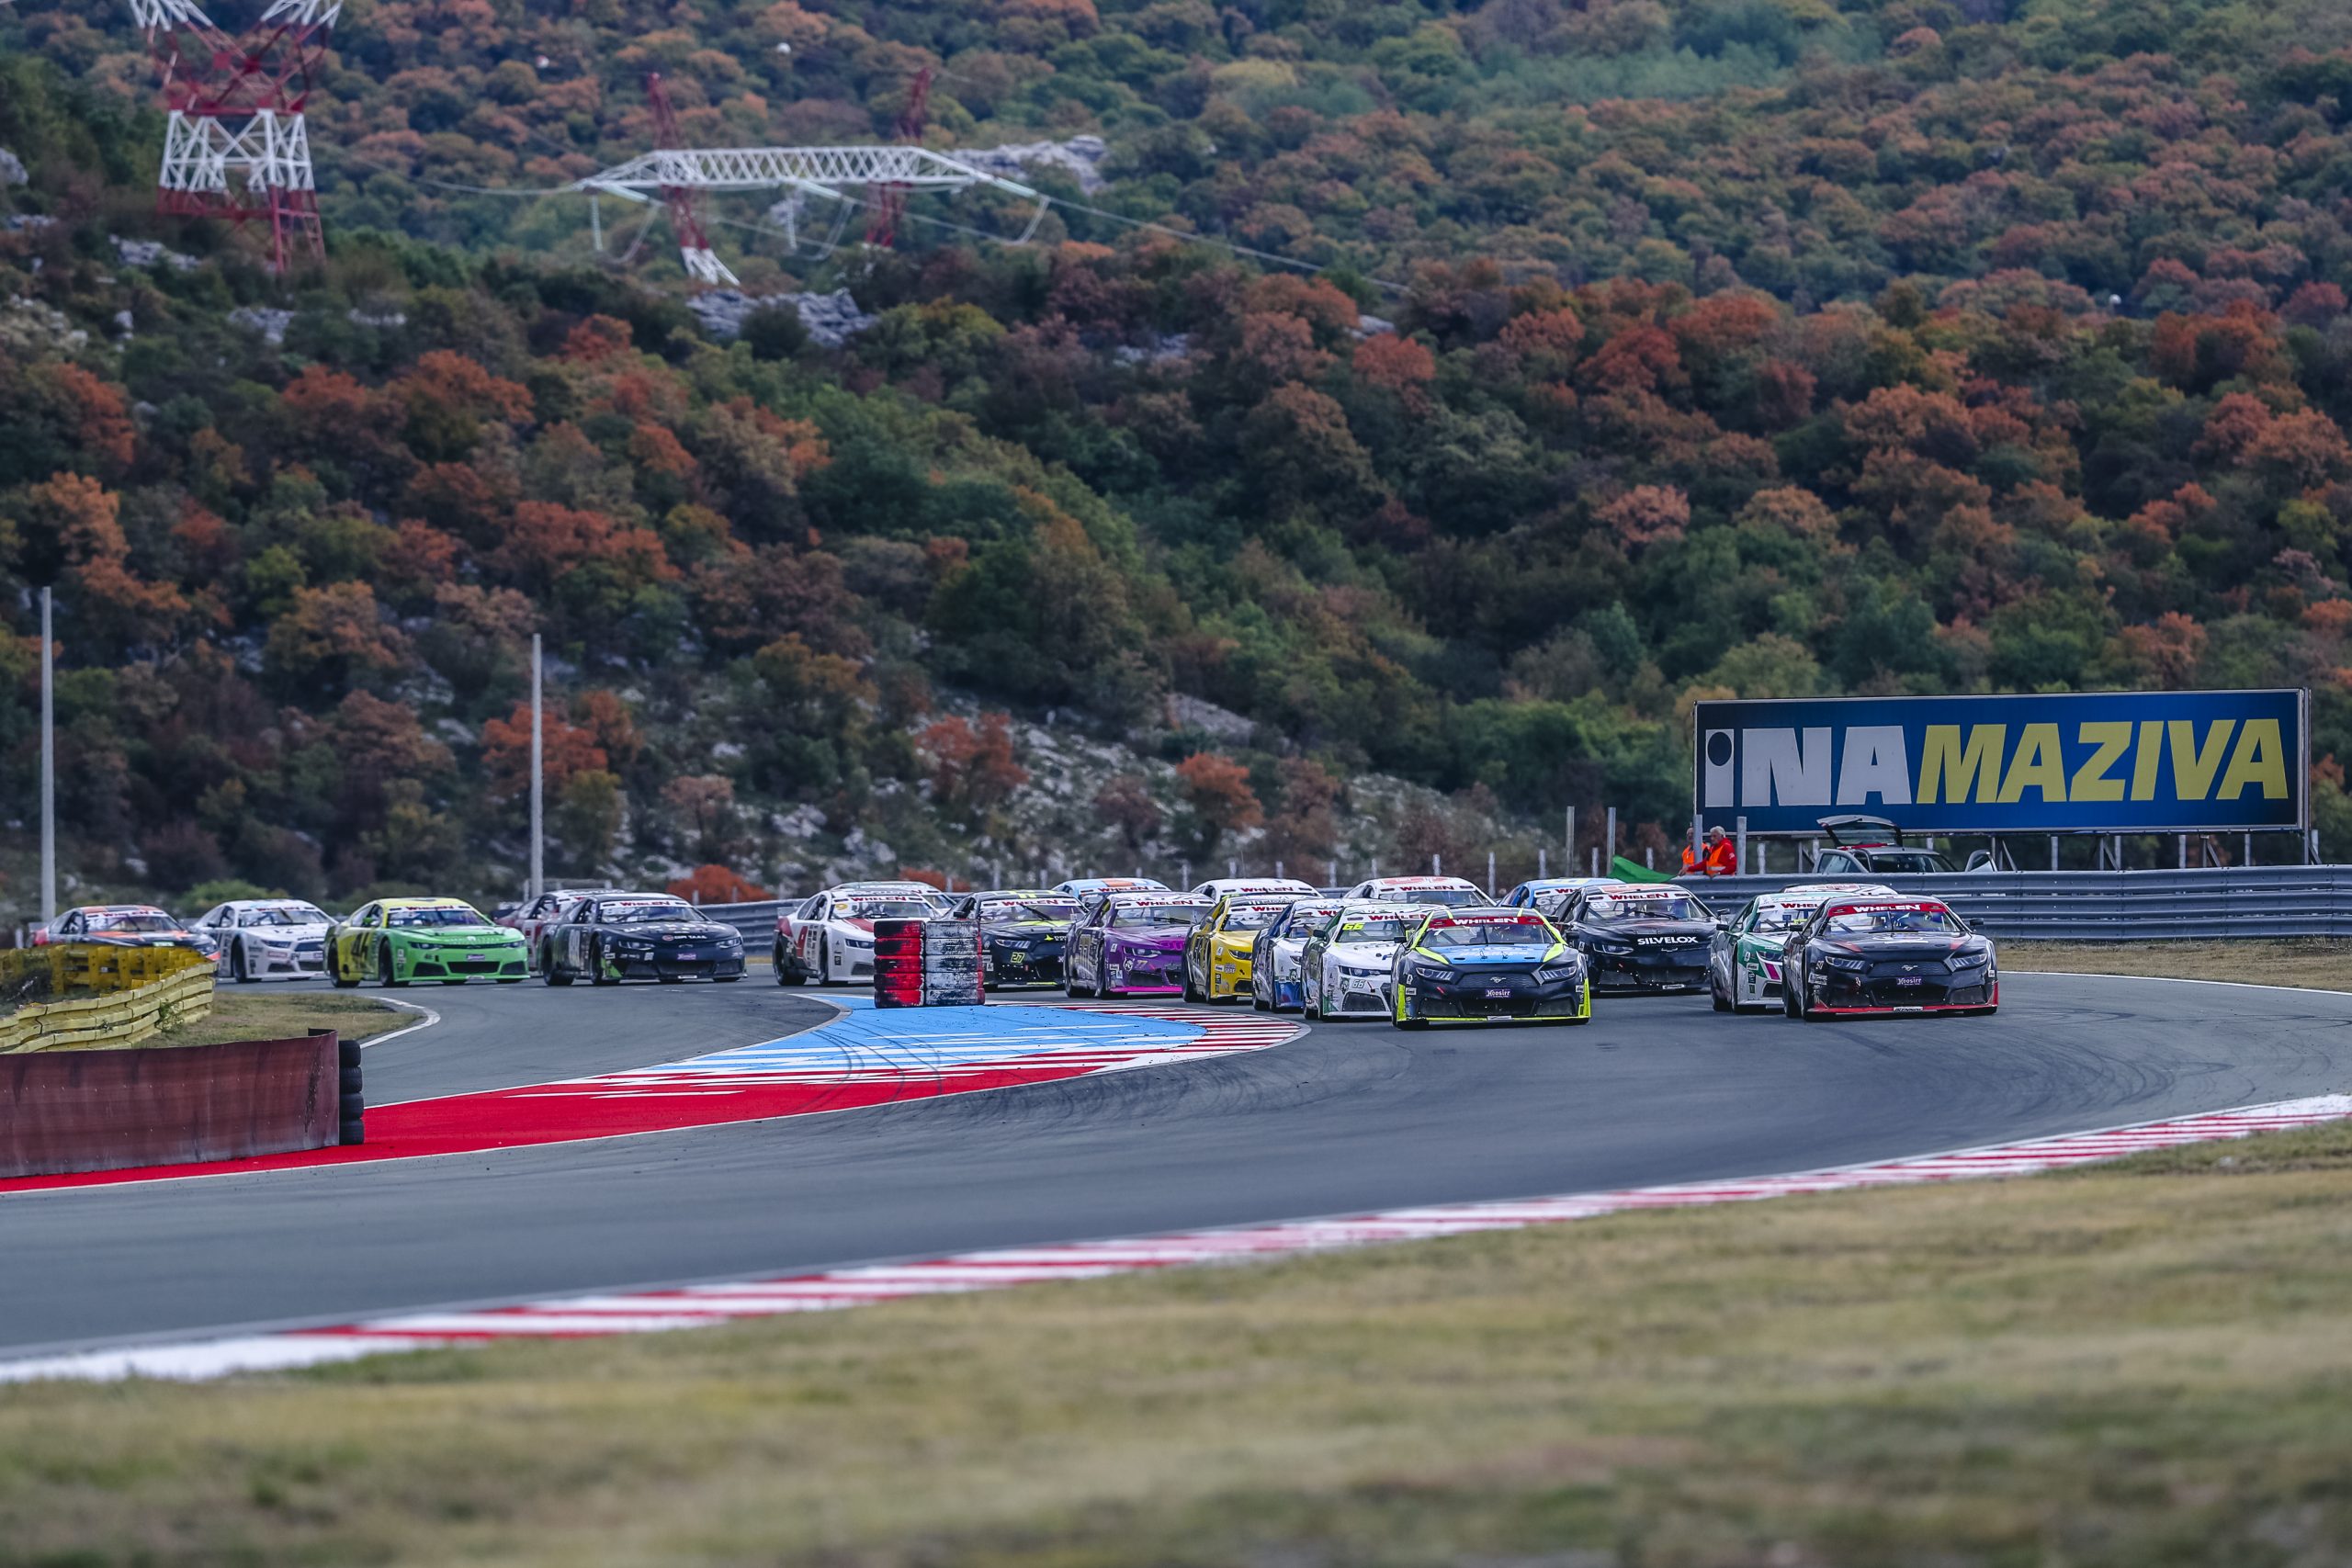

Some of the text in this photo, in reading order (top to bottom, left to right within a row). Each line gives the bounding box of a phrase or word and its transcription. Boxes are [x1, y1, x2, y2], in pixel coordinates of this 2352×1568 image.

[1916, 718, 2289, 805] MAZIVA
[1609, 892, 1668, 900] WHELEN
[1852, 904, 1921, 914] WHELEN
[1342, 922, 1364, 931] 66
[1453, 917, 1519, 926] WHELEN
[1637, 935, 1699, 945] SILVELOX
[1011, 952, 1025, 964] 27
[1136, 959, 1148, 970] 77
[1351, 979, 1365, 989] 66
